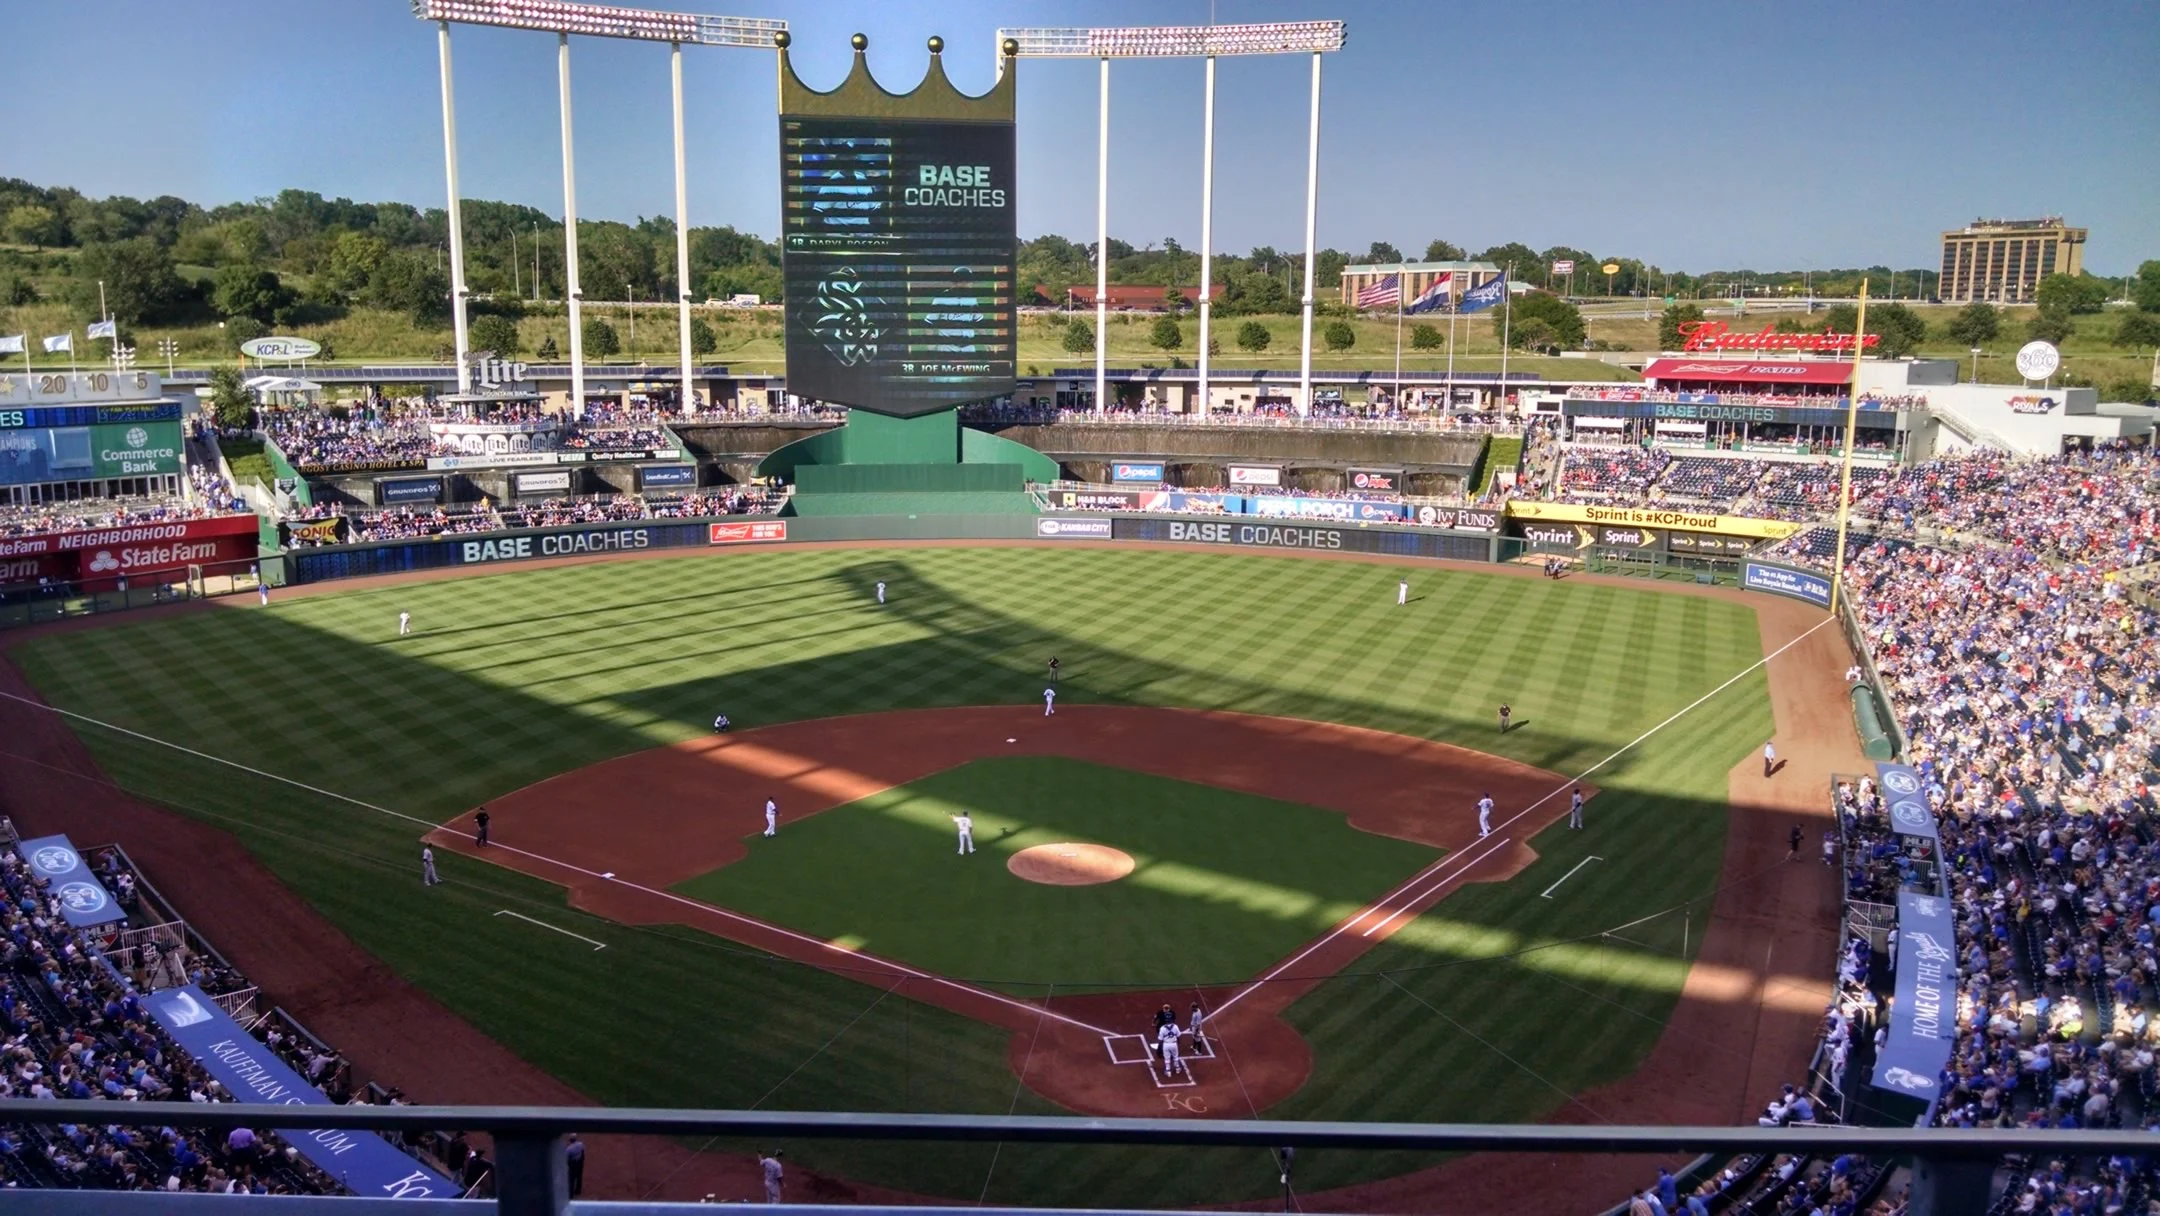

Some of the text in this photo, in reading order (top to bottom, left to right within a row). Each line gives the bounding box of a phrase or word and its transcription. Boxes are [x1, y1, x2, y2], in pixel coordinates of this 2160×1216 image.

[919, 165, 990, 187] BASE
[904, 188, 1005, 208] COACHES
[1677, 320, 1882, 353] Budweiser
[136, 372, 148, 390] 5
[479, 355, 527, 389] Lite
[40, 375, 67, 394] 20
[87, 373, 110, 392] 10
[1655, 405, 1774, 421] BASE COACHES
[2013, 401, 2049, 411] RIVALS
[101, 447, 174, 462] Commerce
[122, 460, 158, 473] Bank
[333, 463, 367, 472] CASINO
[369, 461, 398, 470] HOTEL
[1131, 468, 1157, 478] pepsi
[387, 487, 428, 496] GRUNDFOS
[1077, 496, 1096, 504] H&R
[1300, 502, 1354, 518] PORCH
[1586, 507, 1628, 520] Sprint
[1631, 511, 1642, 522] is
[1645, 512, 1717, 529] #KCProud
[59, 524, 187, 549] NEIGHBORHOOD
[292, 525, 335, 538] SONIC
[1170, 522, 1341, 549] BASE COACHES
[1525, 526, 1573, 547] Sprint
[1606, 529, 1639, 545] Sprint
[464, 529, 648, 563] BASE COACHES
[1906, 836, 1931, 846] MLB
[1912, 961, 1942, 1039] HOME OF THE
[208, 1039, 291, 1100] KAUFFMAN
[1160, 1092, 1208, 1114] KC
